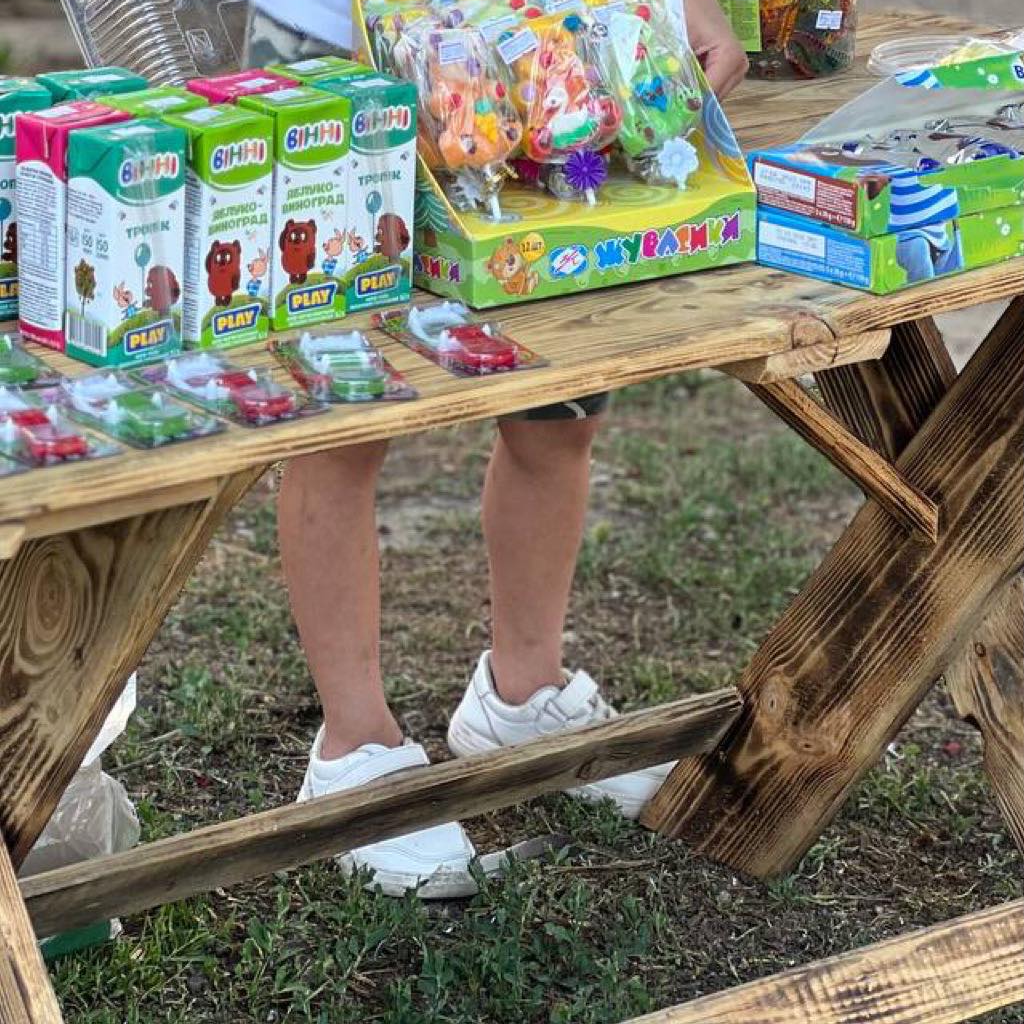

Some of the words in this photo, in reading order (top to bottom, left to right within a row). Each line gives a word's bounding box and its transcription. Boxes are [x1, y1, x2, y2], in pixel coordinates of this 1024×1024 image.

[291, 289, 331, 309] PLAY
[216, 311, 256, 331] PLAY
[127, 326, 167, 350] PLAY
